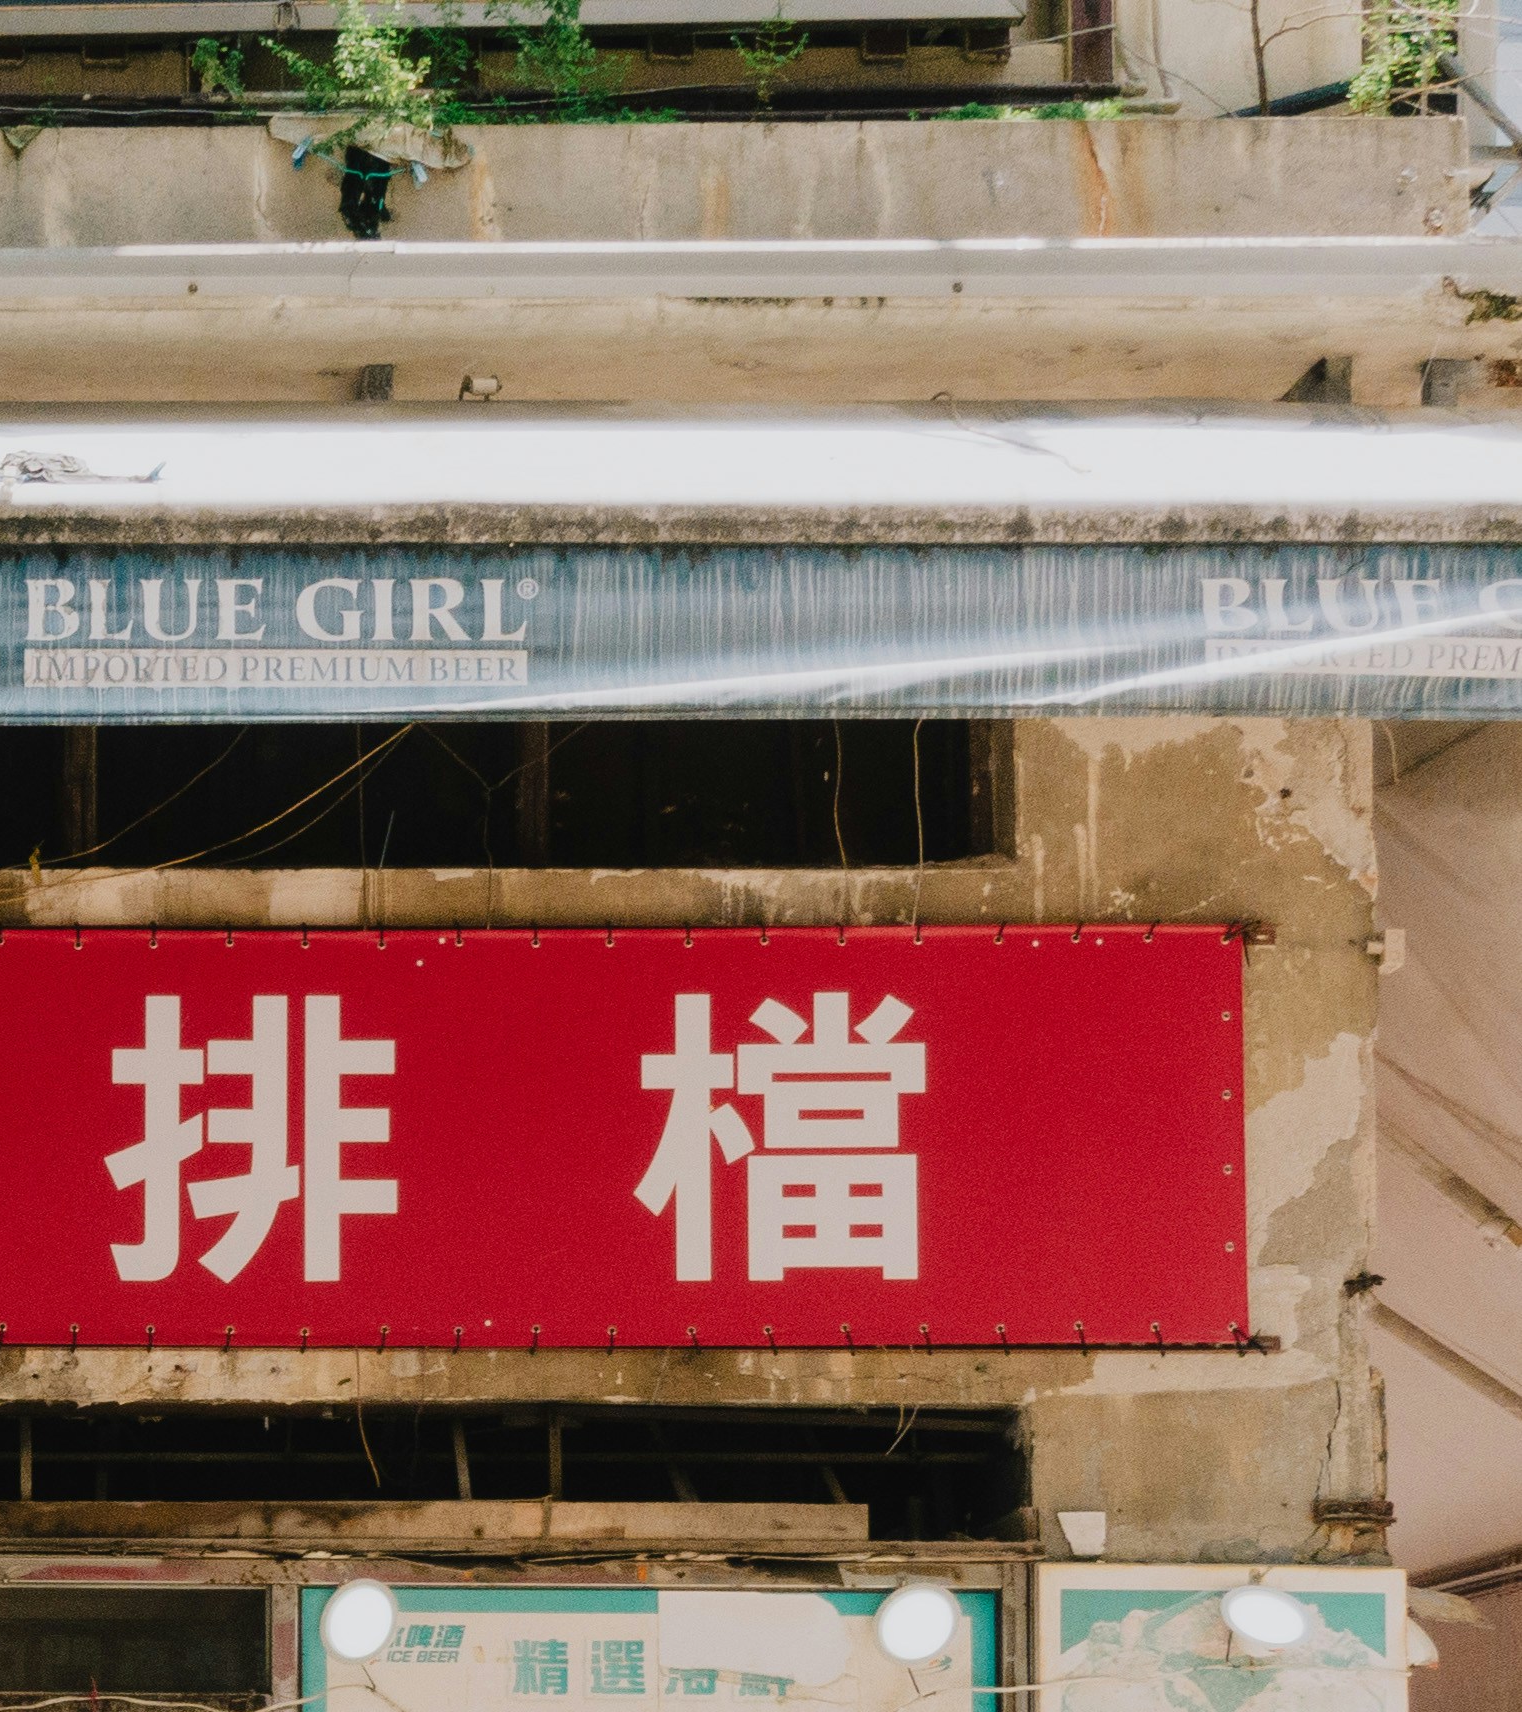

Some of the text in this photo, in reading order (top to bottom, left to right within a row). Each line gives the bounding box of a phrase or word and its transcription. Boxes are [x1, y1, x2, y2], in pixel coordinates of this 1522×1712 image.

[25, 577, 528, 642] BLUE GIRL
[1201, 577, 1441, 632] BLUE
[33, 654, 519, 682] IMPORTED PREMIUM BEER
[387, 1650, 460, 1664] ICE BEER
